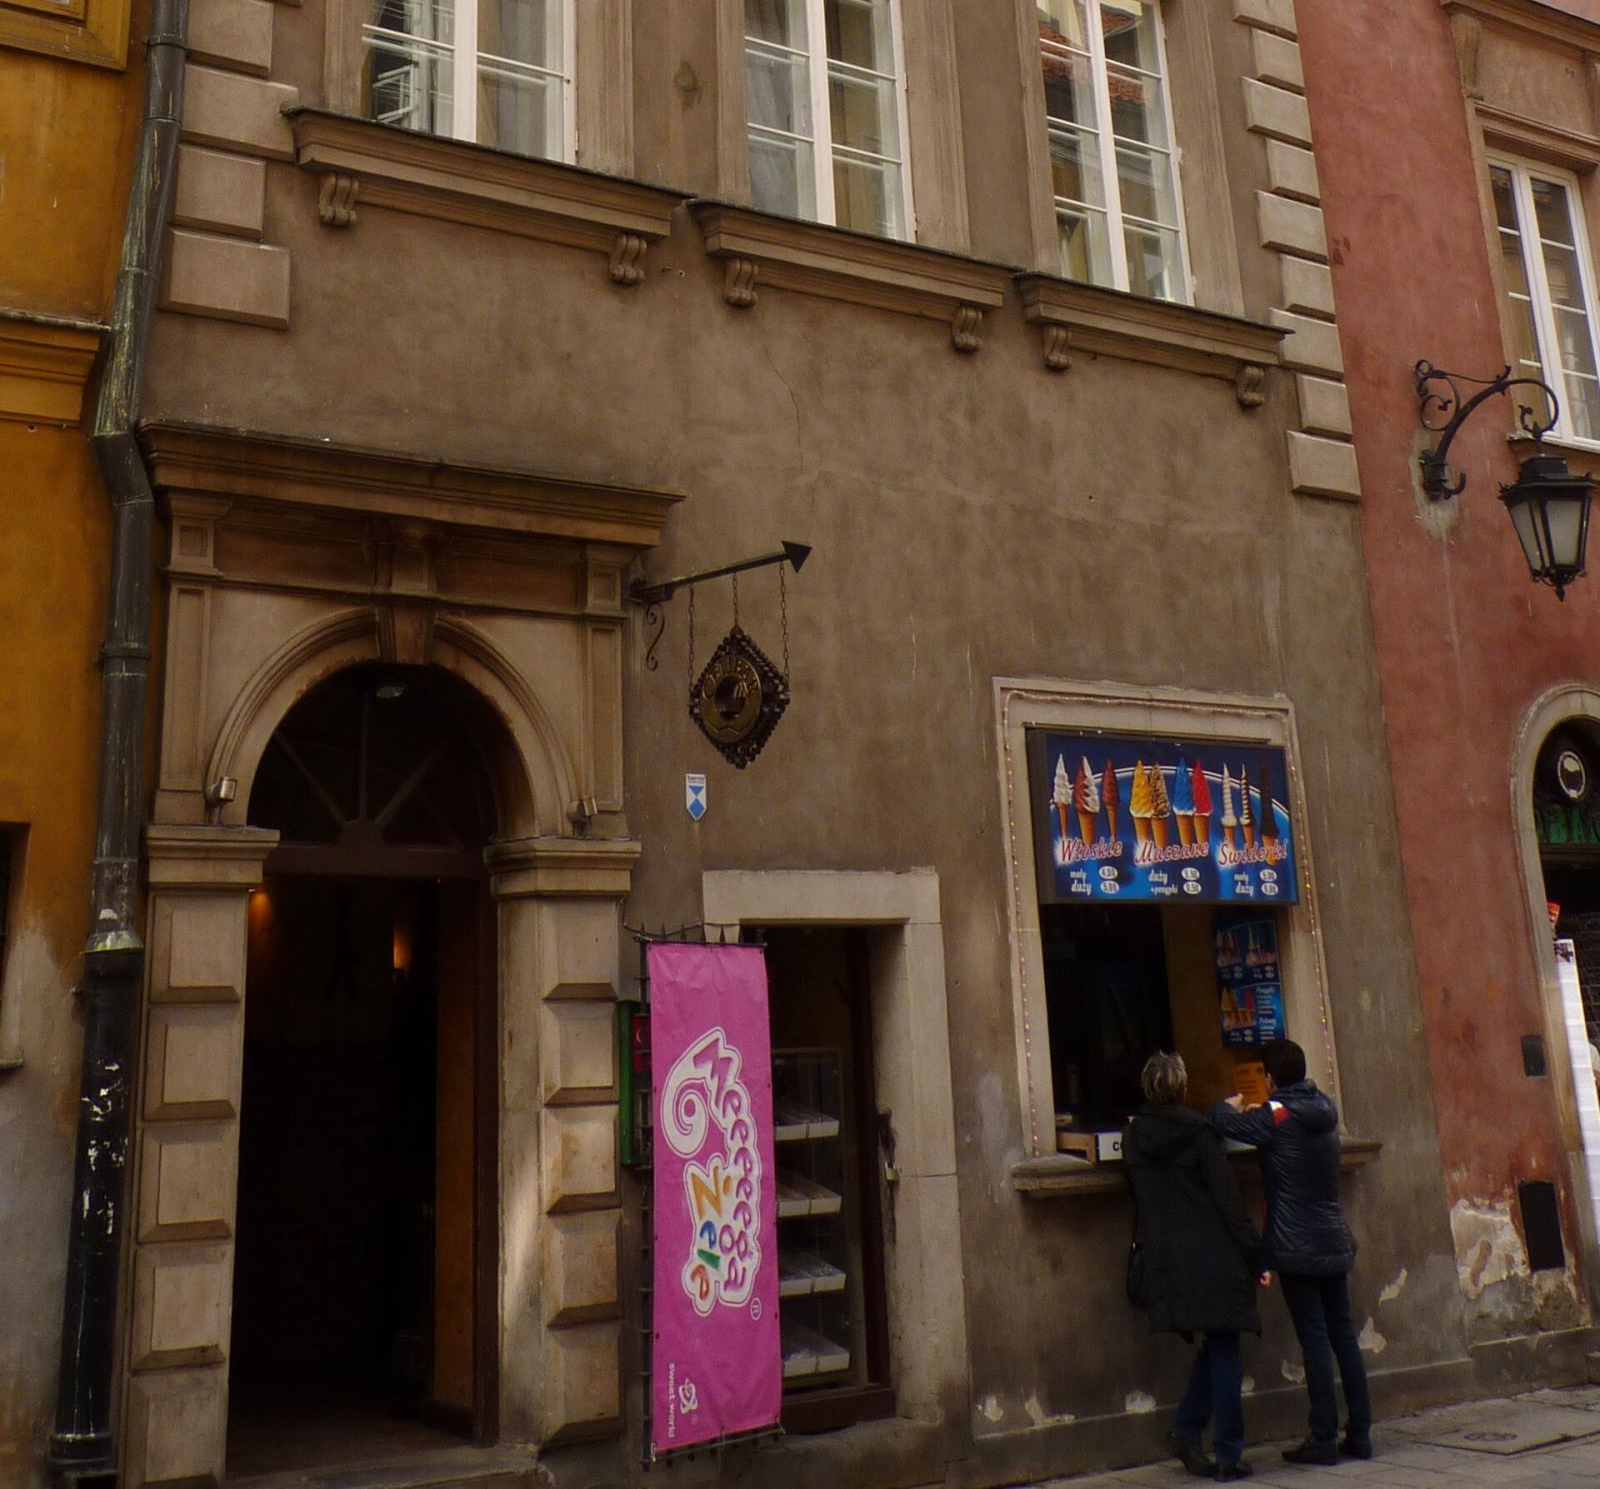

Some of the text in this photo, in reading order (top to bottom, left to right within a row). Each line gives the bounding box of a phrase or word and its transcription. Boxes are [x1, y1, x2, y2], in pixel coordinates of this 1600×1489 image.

[1061, 836, 1122, 862] Włoskie
[1134, 840, 1209, 864] Maczane
[691, 1166, 731, 1300] Żele
